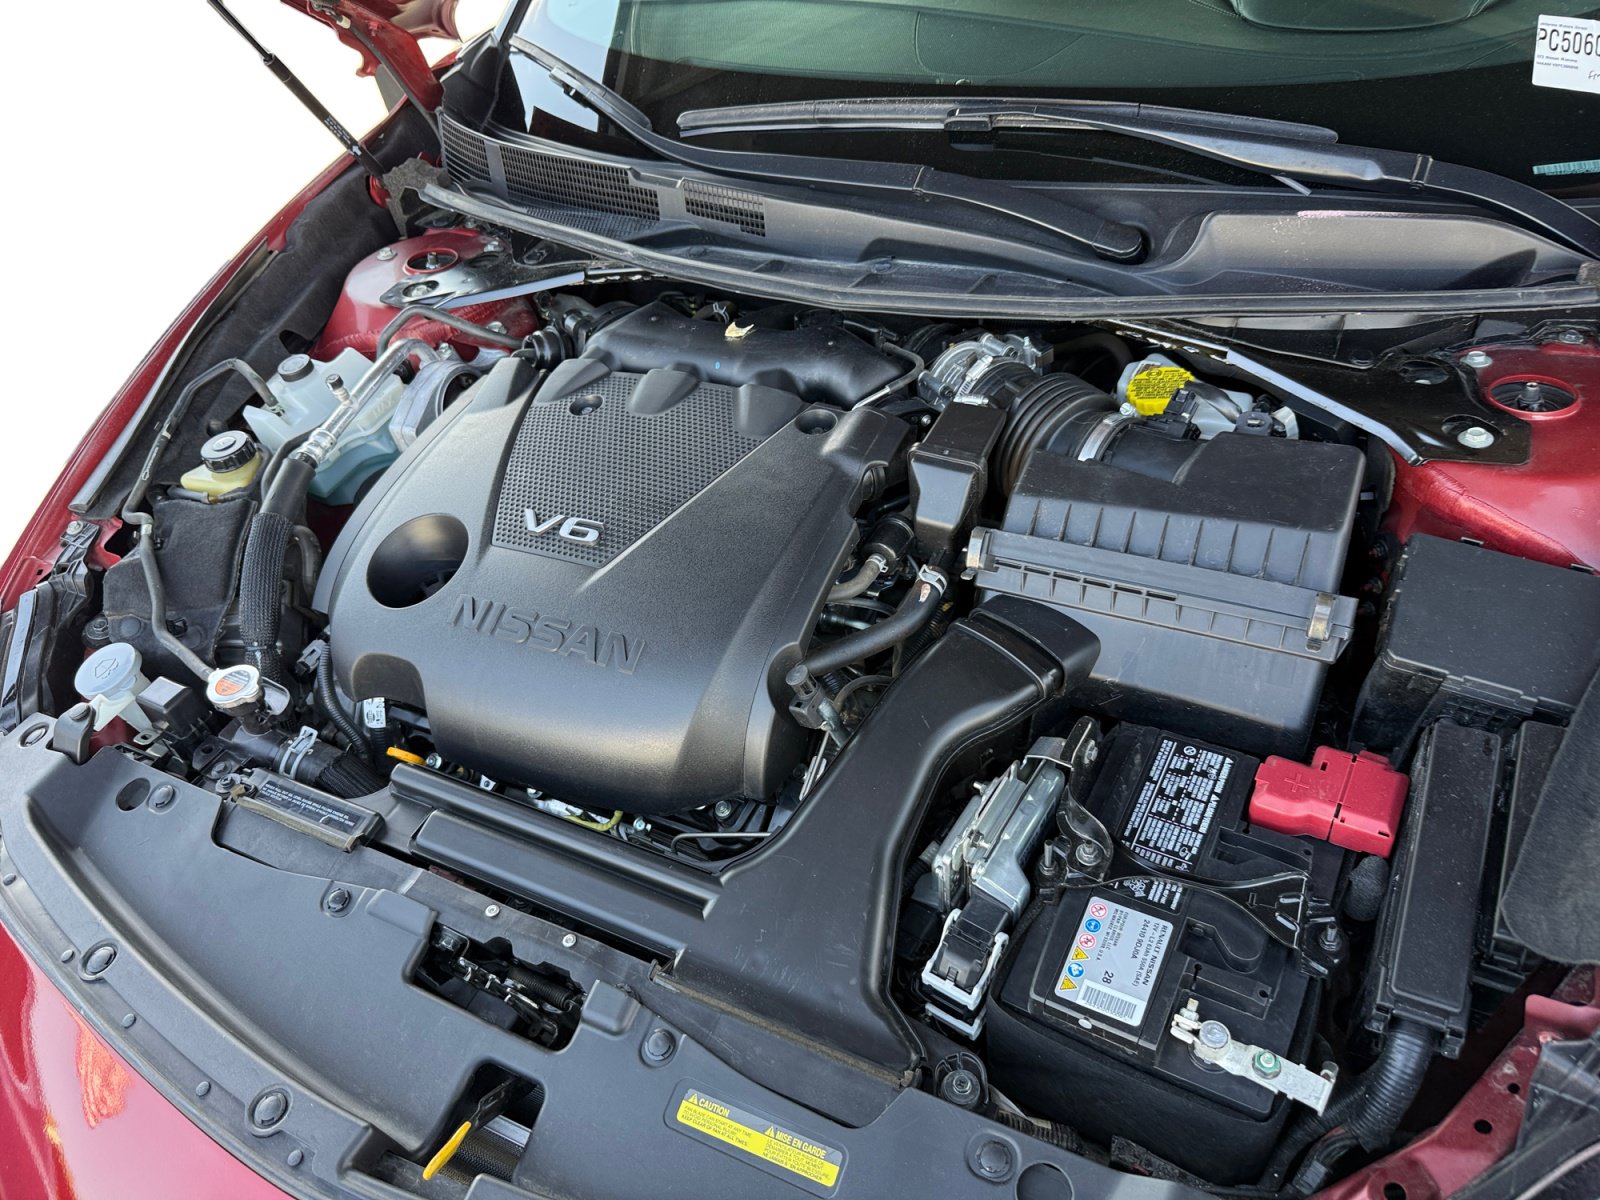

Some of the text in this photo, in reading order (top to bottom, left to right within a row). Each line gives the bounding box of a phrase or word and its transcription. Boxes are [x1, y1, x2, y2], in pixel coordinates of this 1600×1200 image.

[524, 508, 605, 546] V6
[447, 593, 645, 675] NISSAN
[1138, 919, 1150, 938] 24410
[1153, 924, 1168, 953] RENAULT
[1101, 970, 1114, 984] 28
[1142, 954, 1157, 985] NISSAN
[698, 1097, 730, 1117] CAUTION
[775, 1130, 826, 1159] MISE EN GARDE
